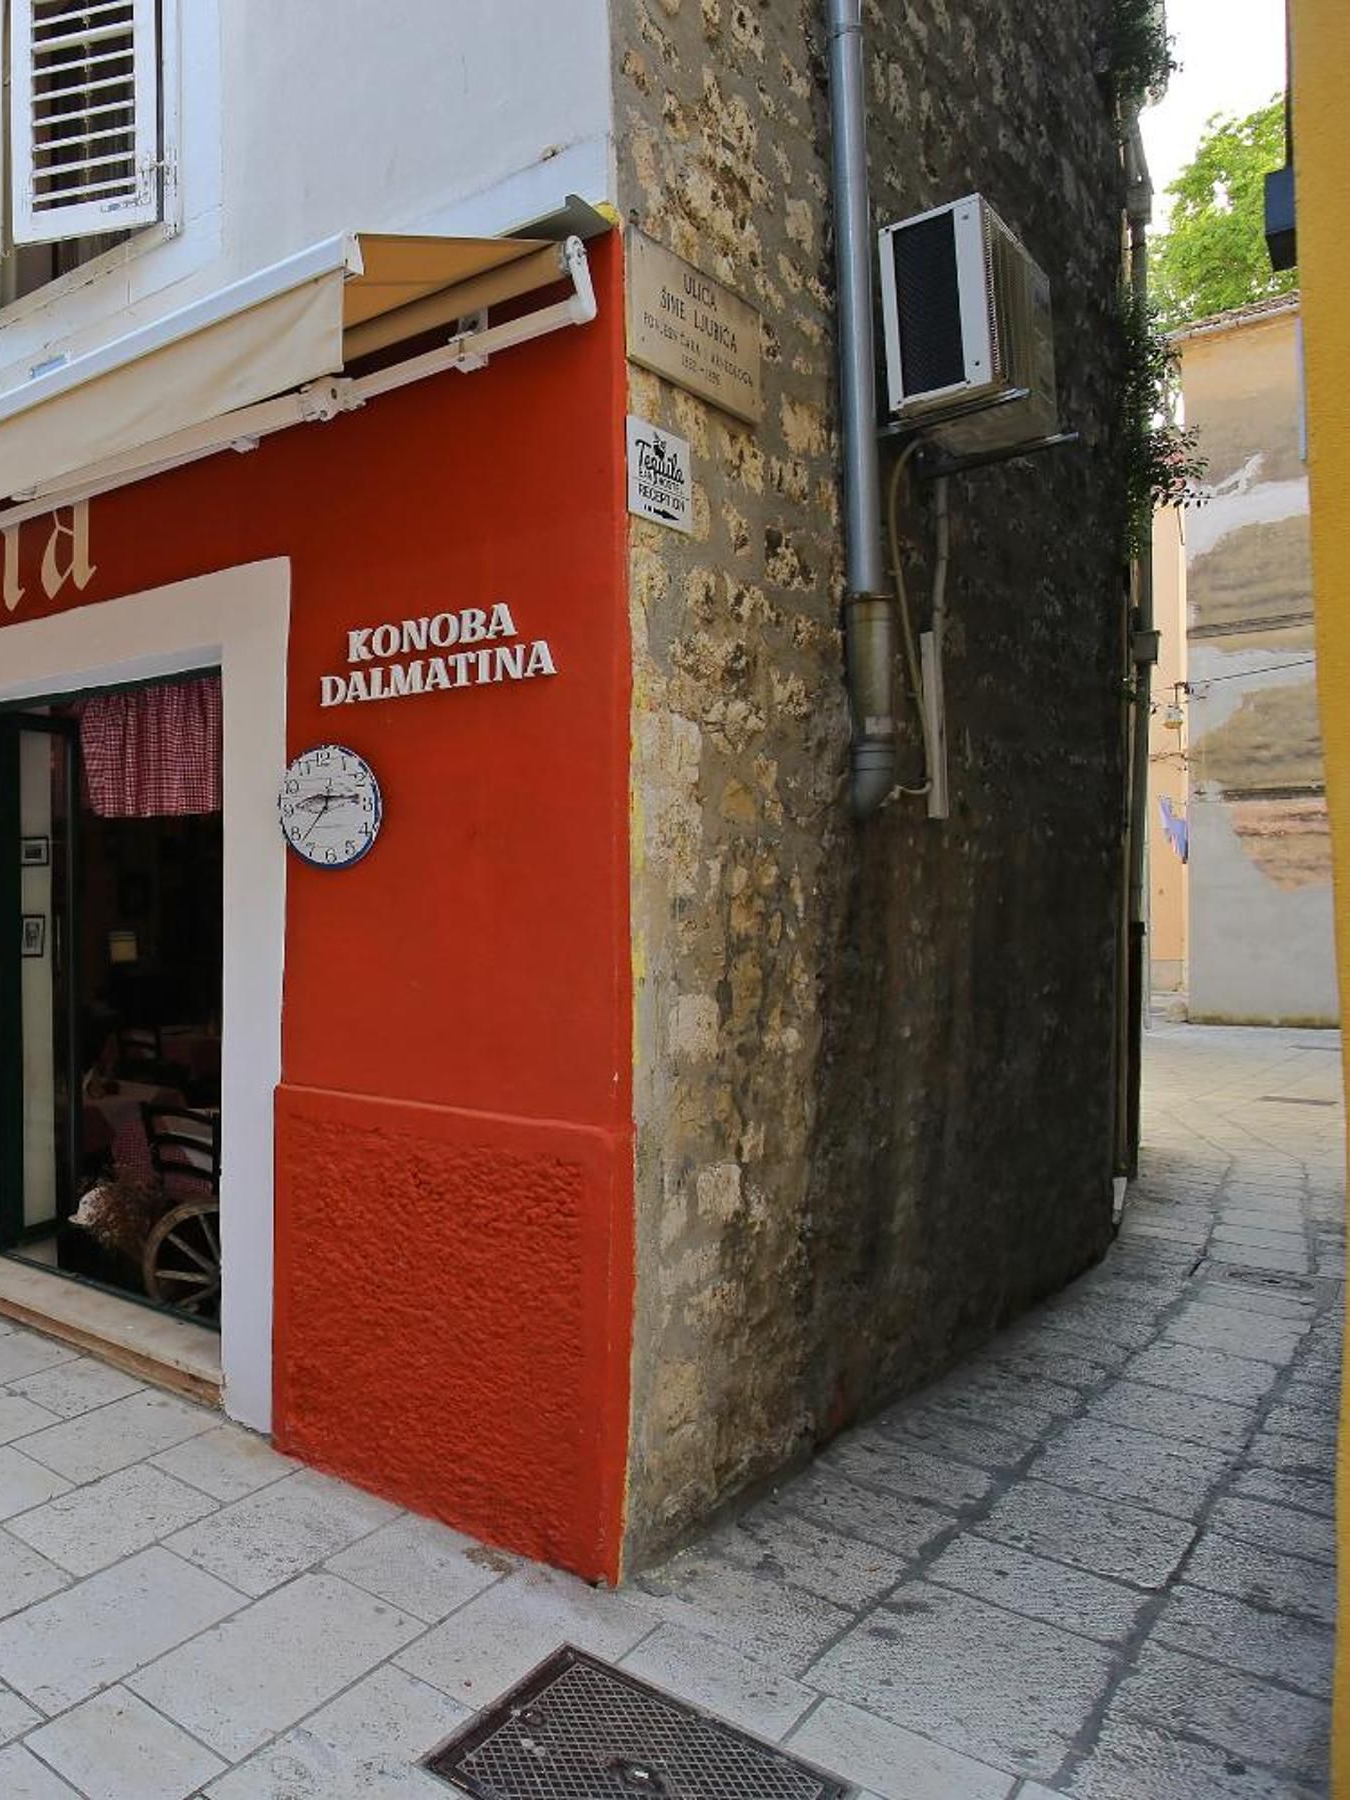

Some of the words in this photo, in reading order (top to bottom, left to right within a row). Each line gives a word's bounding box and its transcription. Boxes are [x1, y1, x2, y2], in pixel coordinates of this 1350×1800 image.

[683, 273, 717, 312] ULICA
[635, 439, 684, 485] Tequila
[347, 602, 518, 664] KONOBA
[319, 640, 559, 707] DALMATINA
[316, 752, 330, 767] 12
[341, 756, 347, 771] 1
[298, 761, 310, 776] 11
[285, 780, 300, 794] 10
[354, 772, 367, 787] 2
[284, 804, 294, 817] 9
[363, 797, 373, 812] 3
[291, 827, 301, 841] 8
[358, 822, 373, 836] 4
[306, 842, 315, 857] 7
[326, 848, 337, 863] 6
[345, 841, 355, 855] 5
